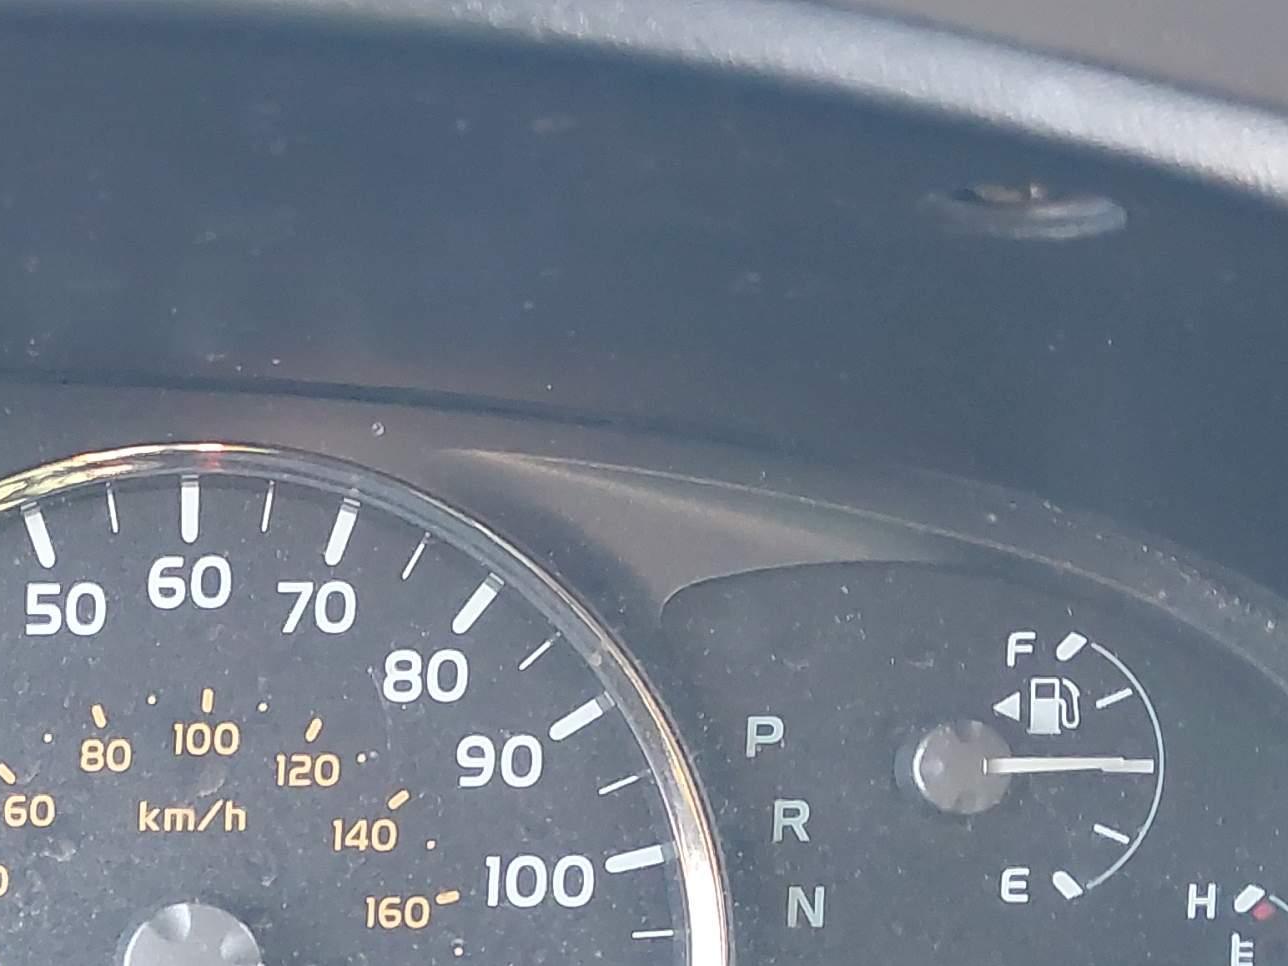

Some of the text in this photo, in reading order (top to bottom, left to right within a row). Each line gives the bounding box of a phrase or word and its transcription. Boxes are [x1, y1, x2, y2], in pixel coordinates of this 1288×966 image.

[147, 555, 232, 610] 60
[24, 580, 108, 637] 50
[276, 580, 358, 635] 70
[1007, 631, 1036, 666] F
[382, 648, 469, 703] 80
[172, 721, 241, 757] 100
[746, 715, 785, 758] P
[79, 738, 132, 773] 80
[275, 753, 341, 788] 120
[455, 733, 543, 789] 90
[3, 795, 56, 828] 60
[138, 799, 247, 833] km/h
[773, 799, 811, 842] R
[331, 818, 398, 852] 140
[484, 854, 595, 907] 100
[1001, 868, 1030, 902] E
[365, 895, 431, 929] 160
[787, 886, 825, 929] N
[1188, 884, 1217, 920] H
